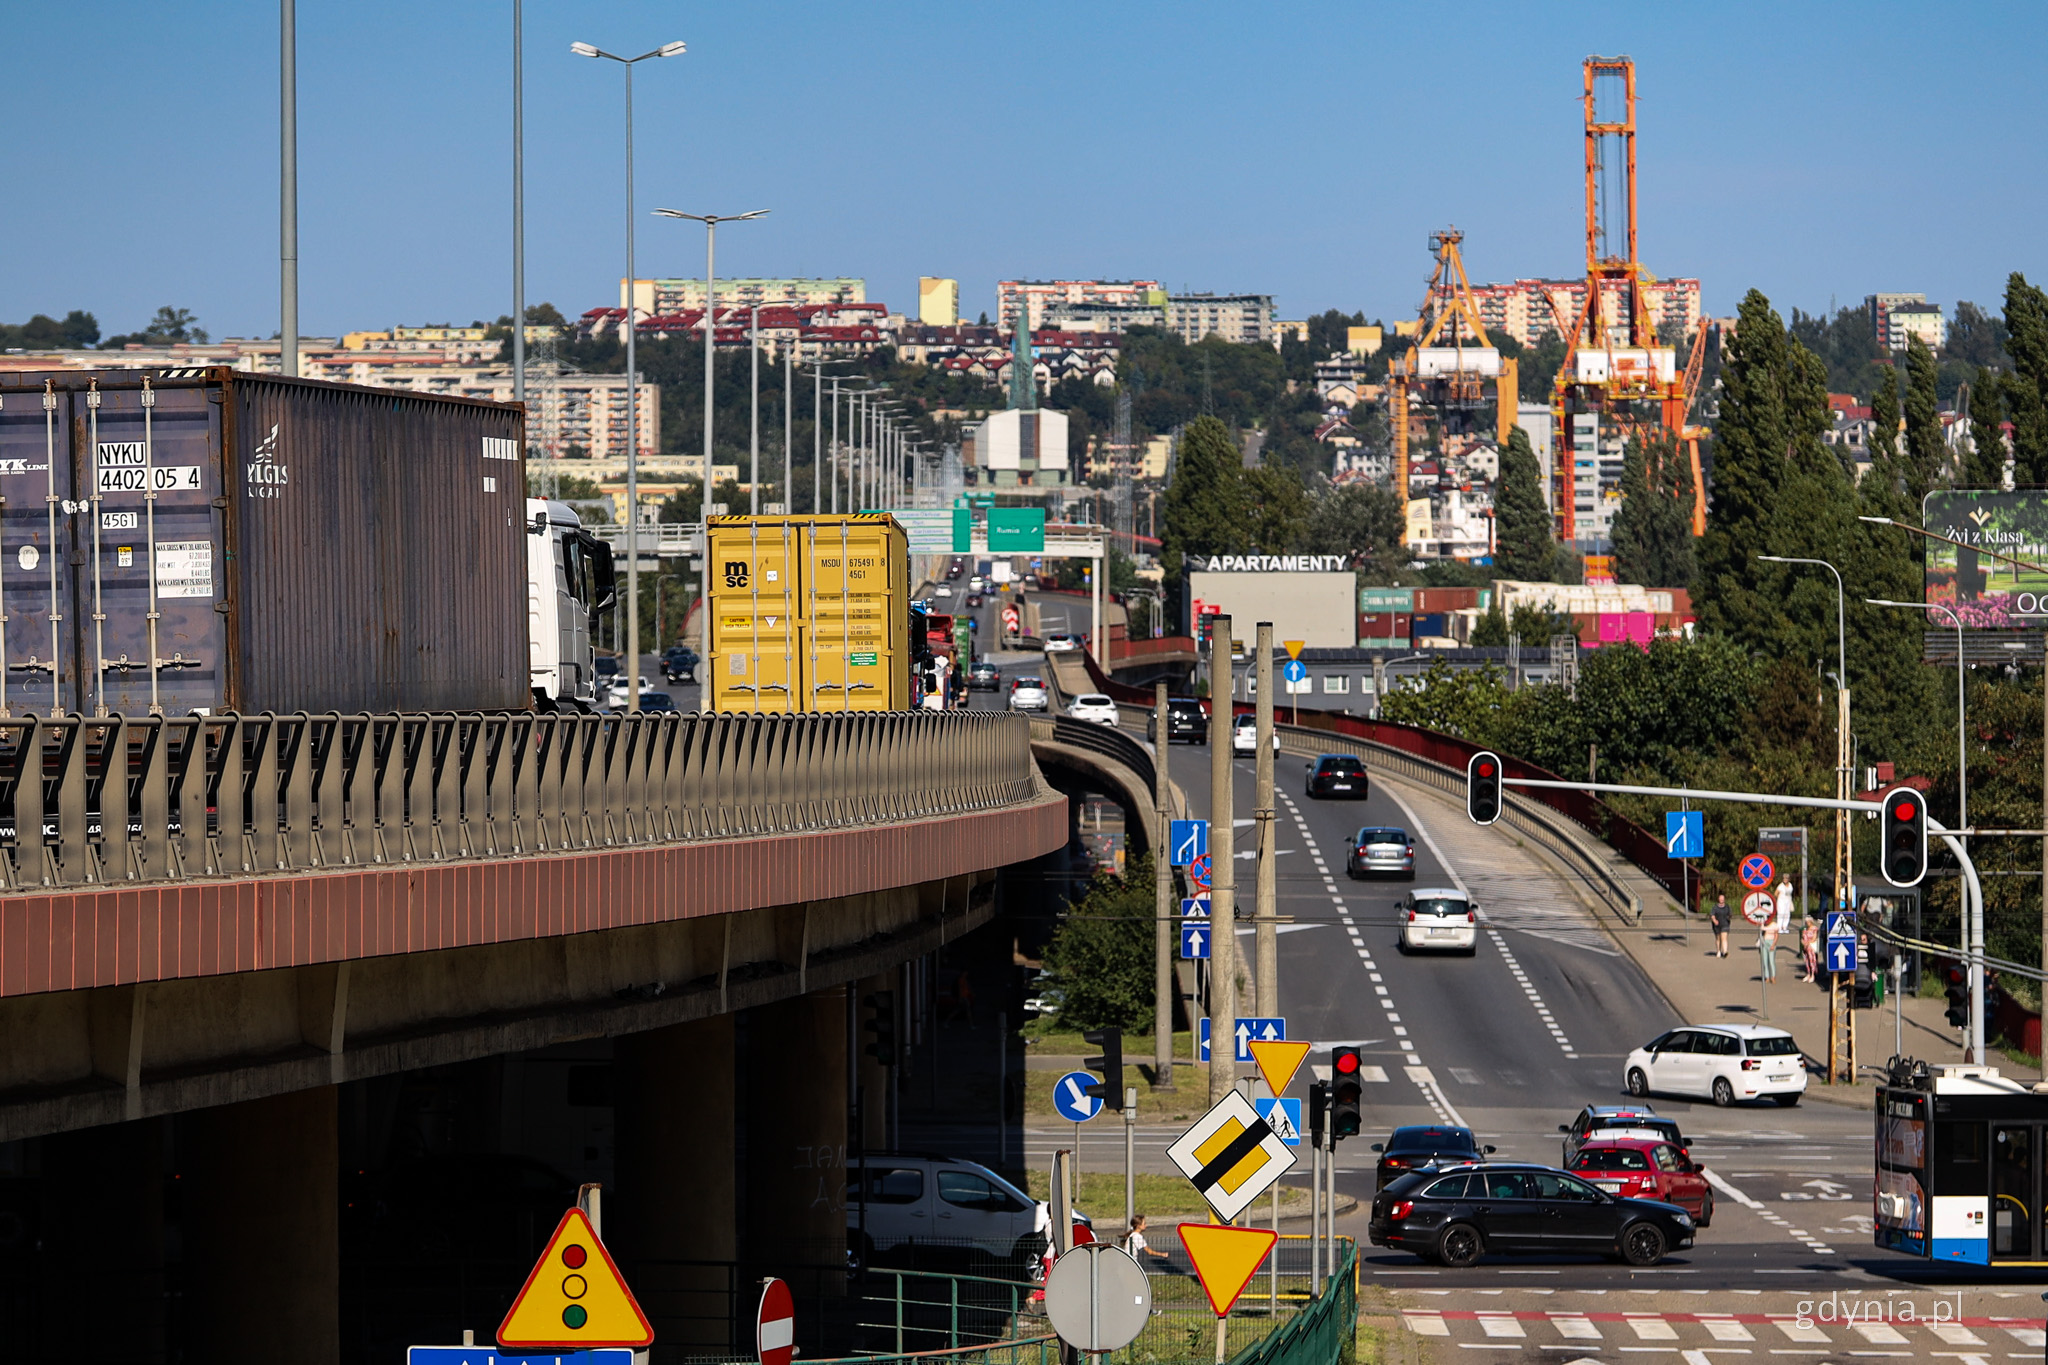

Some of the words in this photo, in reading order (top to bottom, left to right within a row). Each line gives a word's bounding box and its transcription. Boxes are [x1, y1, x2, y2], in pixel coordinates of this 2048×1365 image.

[99, 443, 144, 465] NYKU
[101, 470, 145, 490] 4402
[155, 468, 177, 488] 05
[188, 467, 199, 488] 4
[103, 513, 134, 527] 45G1
[821, 559, 841, 568] MSDU
[849, 558, 875, 567] 675491
[880, 558, 886, 566] 8
[1207, 555, 1347, 571] APARTAMENTY
[849, 570, 866, 579] 45G1
